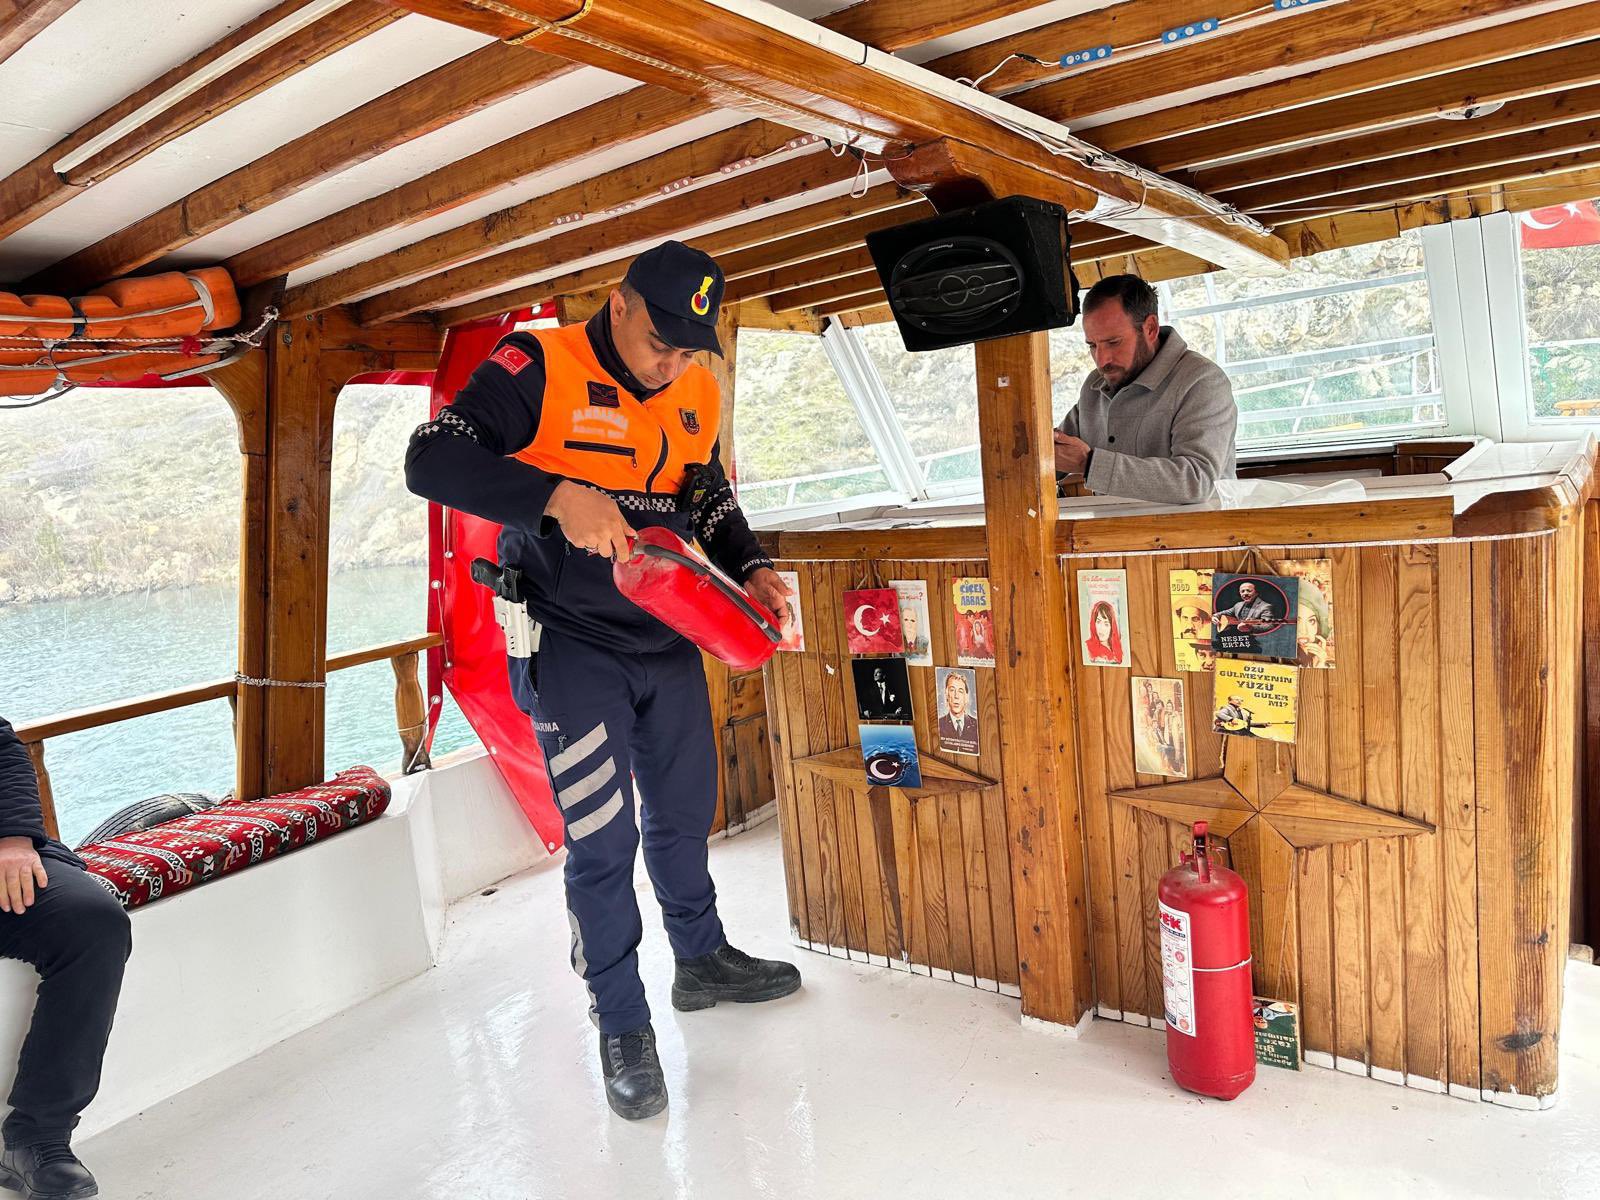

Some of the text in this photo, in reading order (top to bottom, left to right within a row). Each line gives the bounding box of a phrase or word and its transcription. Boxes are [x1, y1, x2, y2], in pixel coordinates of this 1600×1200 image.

[961, 596, 986, 606] ABBAS
[1220, 670, 1292, 683] GÜLMEYENİN
[1237, 680, 1274, 691] YÜZÜ
[1254, 692, 1288, 701] GÜLER
